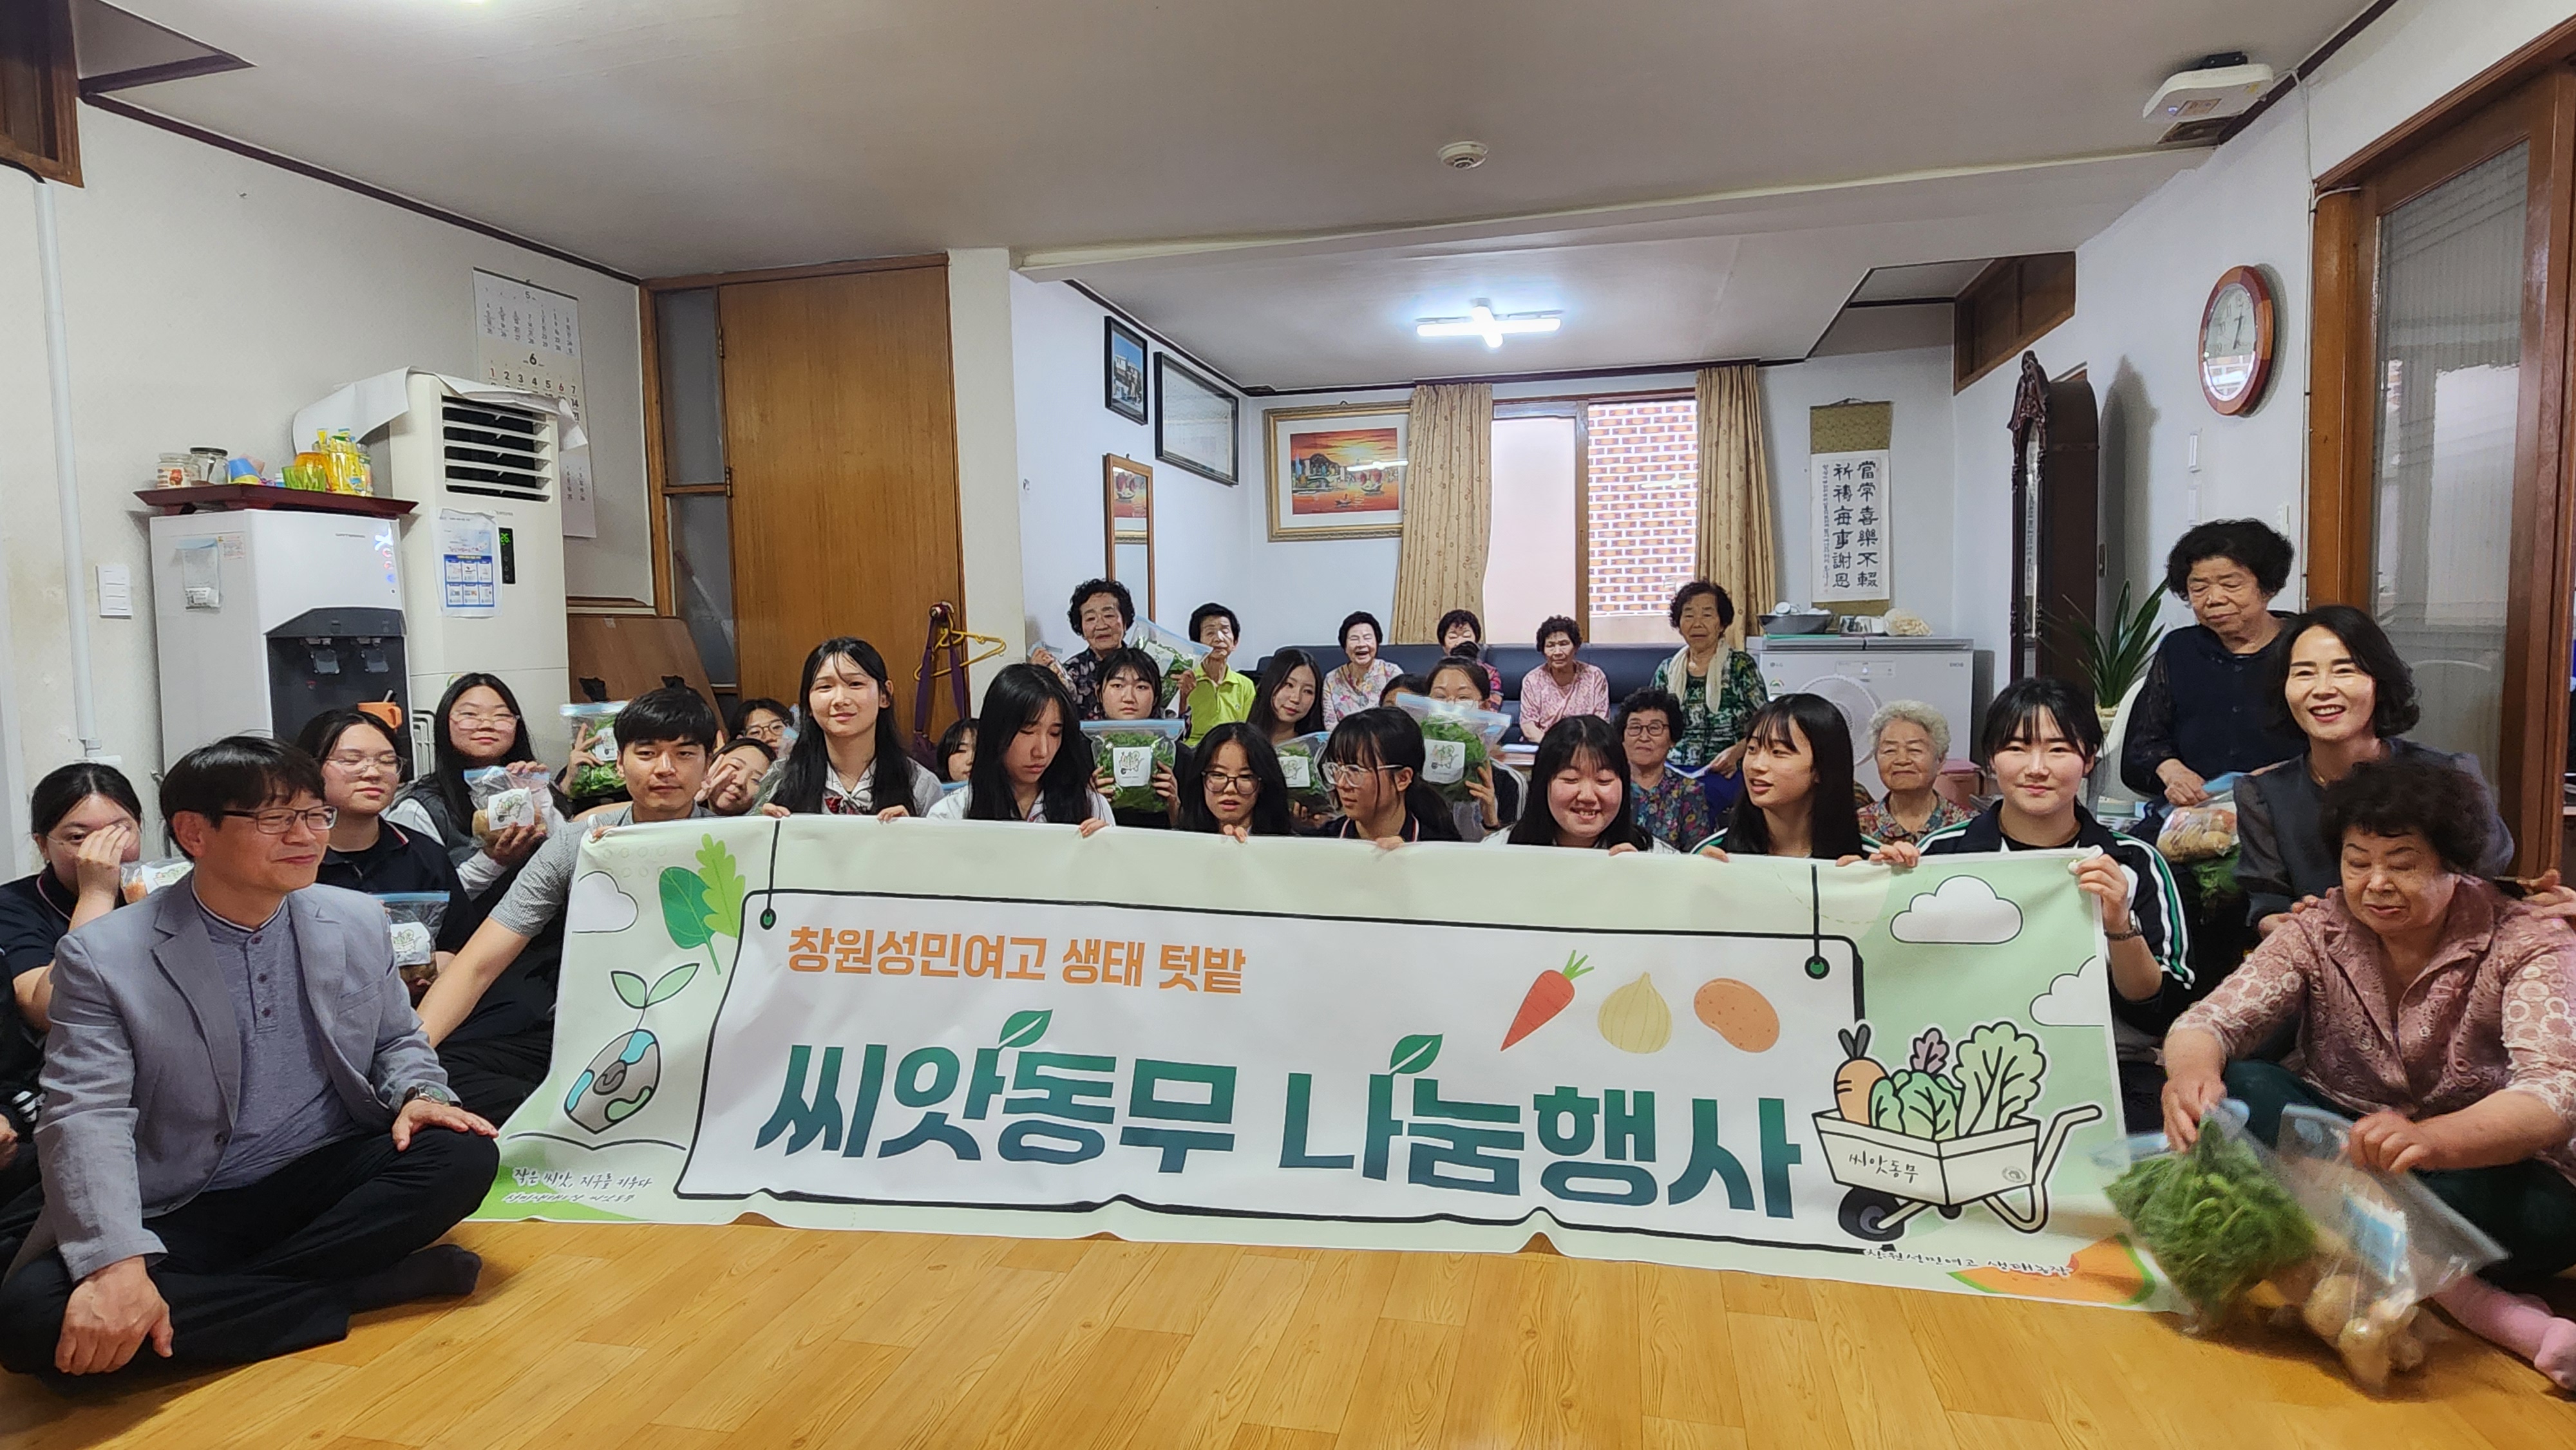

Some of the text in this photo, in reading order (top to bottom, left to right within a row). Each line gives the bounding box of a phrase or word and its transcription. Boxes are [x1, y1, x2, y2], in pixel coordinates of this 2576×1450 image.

[529, 353, 537, 365] 6
[504, 371, 510, 380] 2
[518, 374, 524, 382] 3
[531, 377, 538, 386] 4
[545, 380, 551, 389] 5
[559, 383, 564, 391] 6
[571, 385, 576, 394] 7
[788, 926, 1246, 994] 창원성민여고 생태 텃밭
[753, 1044, 1802, 1219] 씨앗동무 나눔행사
[515, 1168, 538, 1184] 작은
[580, 1172, 612, 1190] 지구를
[1848, 1150, 1918, 1184] 씨앗동무
